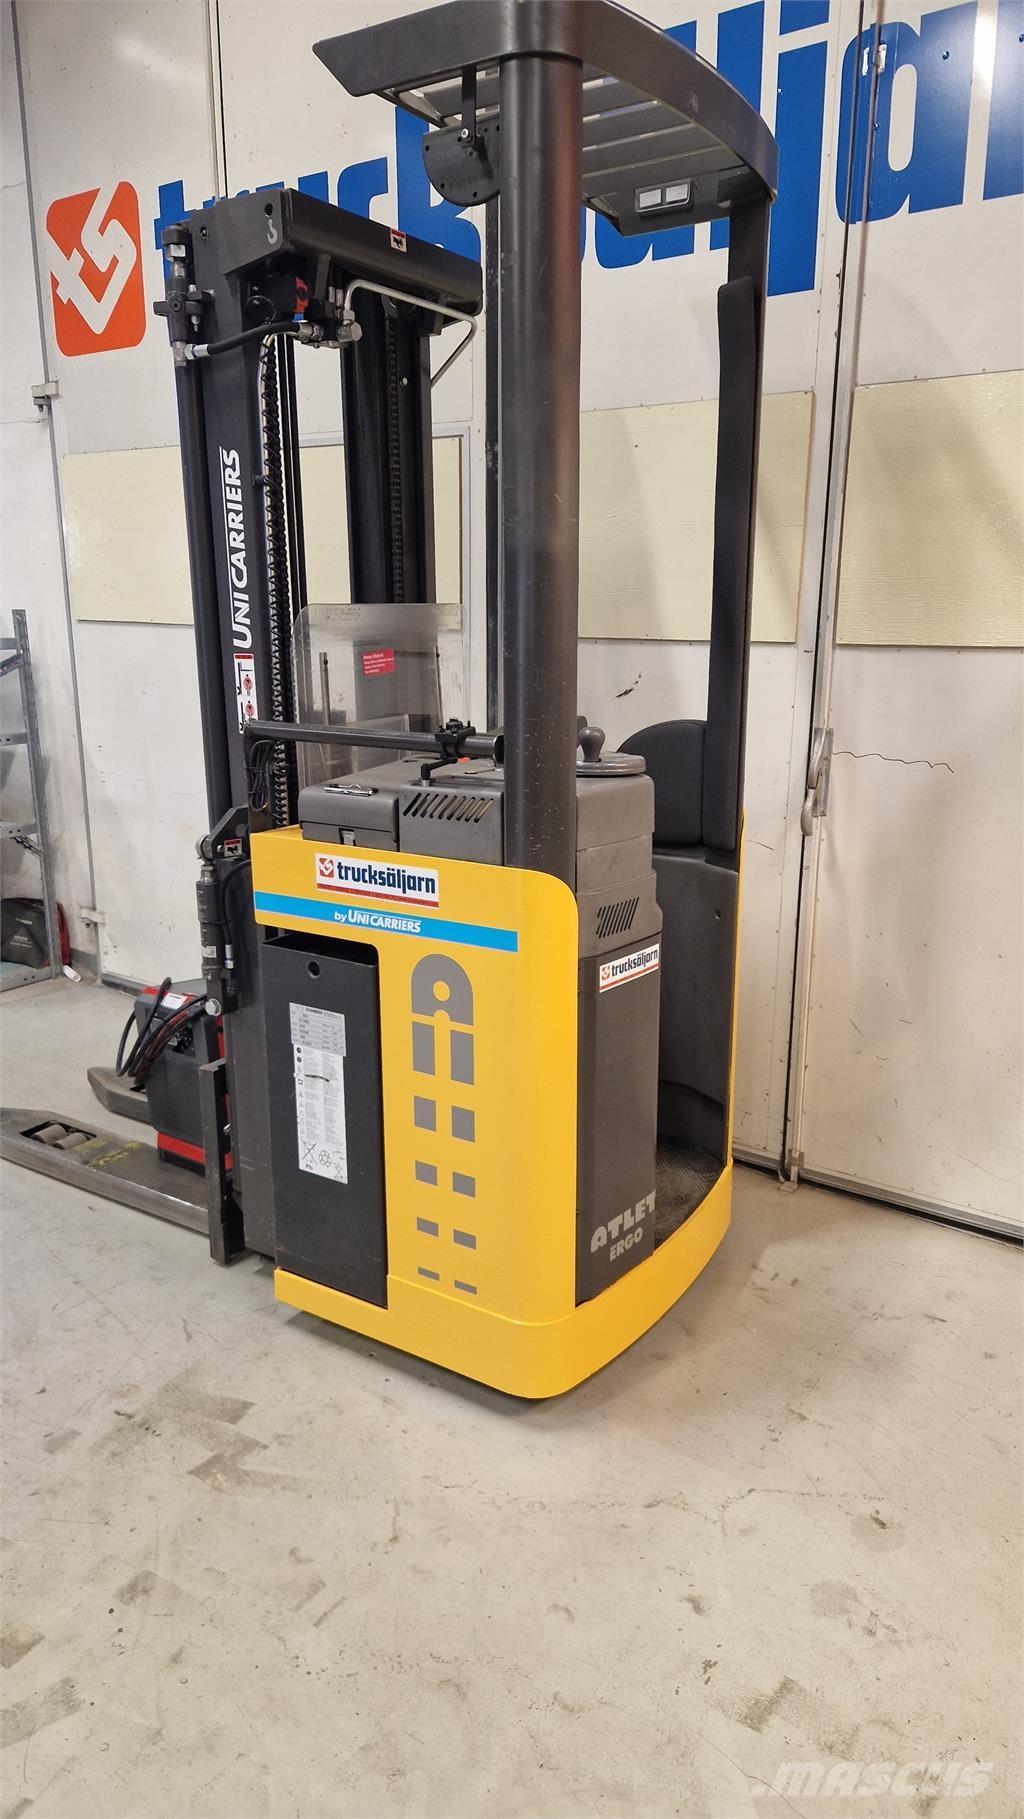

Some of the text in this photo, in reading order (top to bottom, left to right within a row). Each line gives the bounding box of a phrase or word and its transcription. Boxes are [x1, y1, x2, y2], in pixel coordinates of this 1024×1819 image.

[223, 449, 252, 649] UNICARRIERS
[337, 861, 436, 894] trucksäljarn
[334, 909, 422, 933] by UNICARRIERS
[590, 1187, 657, 1253] ATLET
[609, 1226, 644, 1263] ERGO
